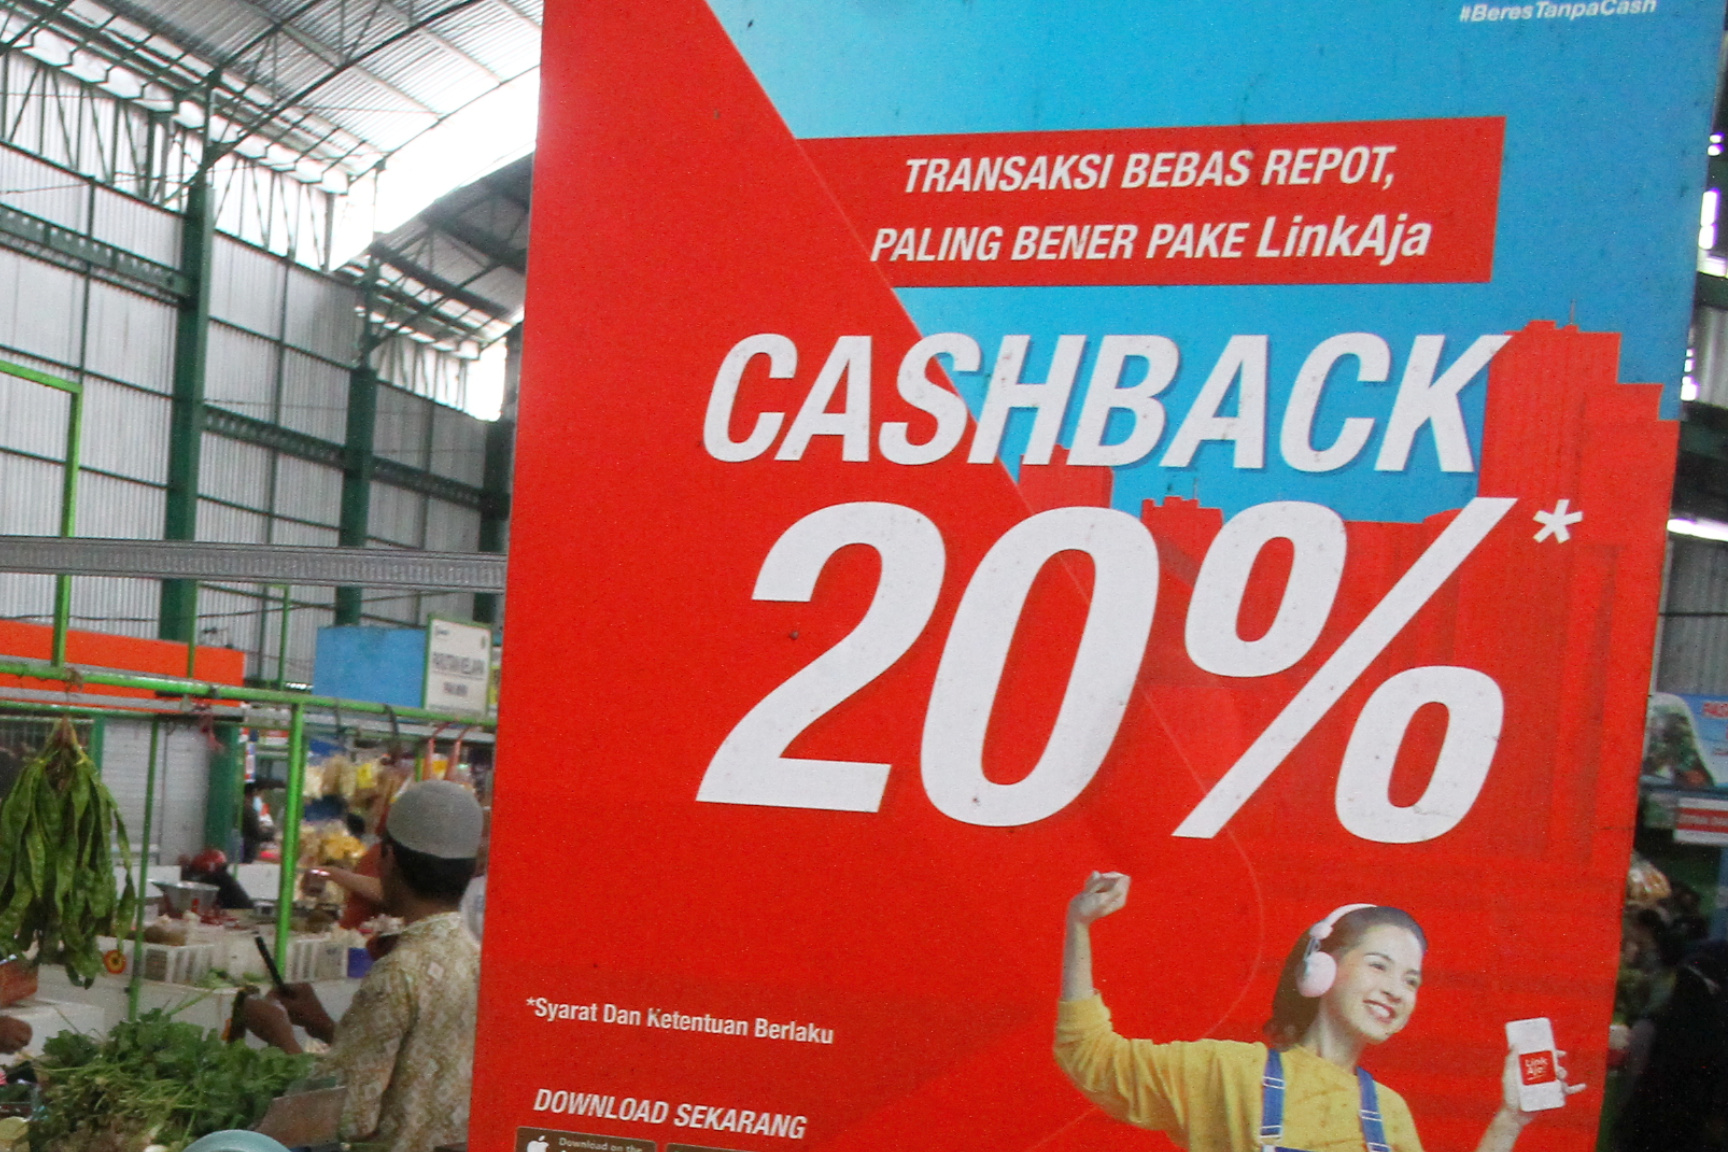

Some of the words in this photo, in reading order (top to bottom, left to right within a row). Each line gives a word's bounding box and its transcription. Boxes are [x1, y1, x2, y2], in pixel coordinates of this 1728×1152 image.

[1459, 0, 1657, 22] #BeresTanpaCash
[904, 153, 1115, 193] TRANSAKSI
[1120, 149, 1255, 189] BEBAS
[1260, 145, 1397, 190] REPOT,
[870, 225, 1004, 262] PALING
[1010, 223, 1139, 260] BENER
[1145, 222, 1250, 259] PAKE
[1255, 213, 1432, 266] LinkAja
[702, 331, 1512, 473] CASHBACK
[603, 1003, 642, 1026] Dan
[646, 1006, 749, 1037] Ketentuan
[754, 1017, 835, 1045] Berlaku
[533, 1088, 670, 1126] DOWNLOAD
[673, 1102, 809, 1140] SEKARANG
[558, 1136, 609, 1152] Download
[610, 1143, 624, 1152] on
